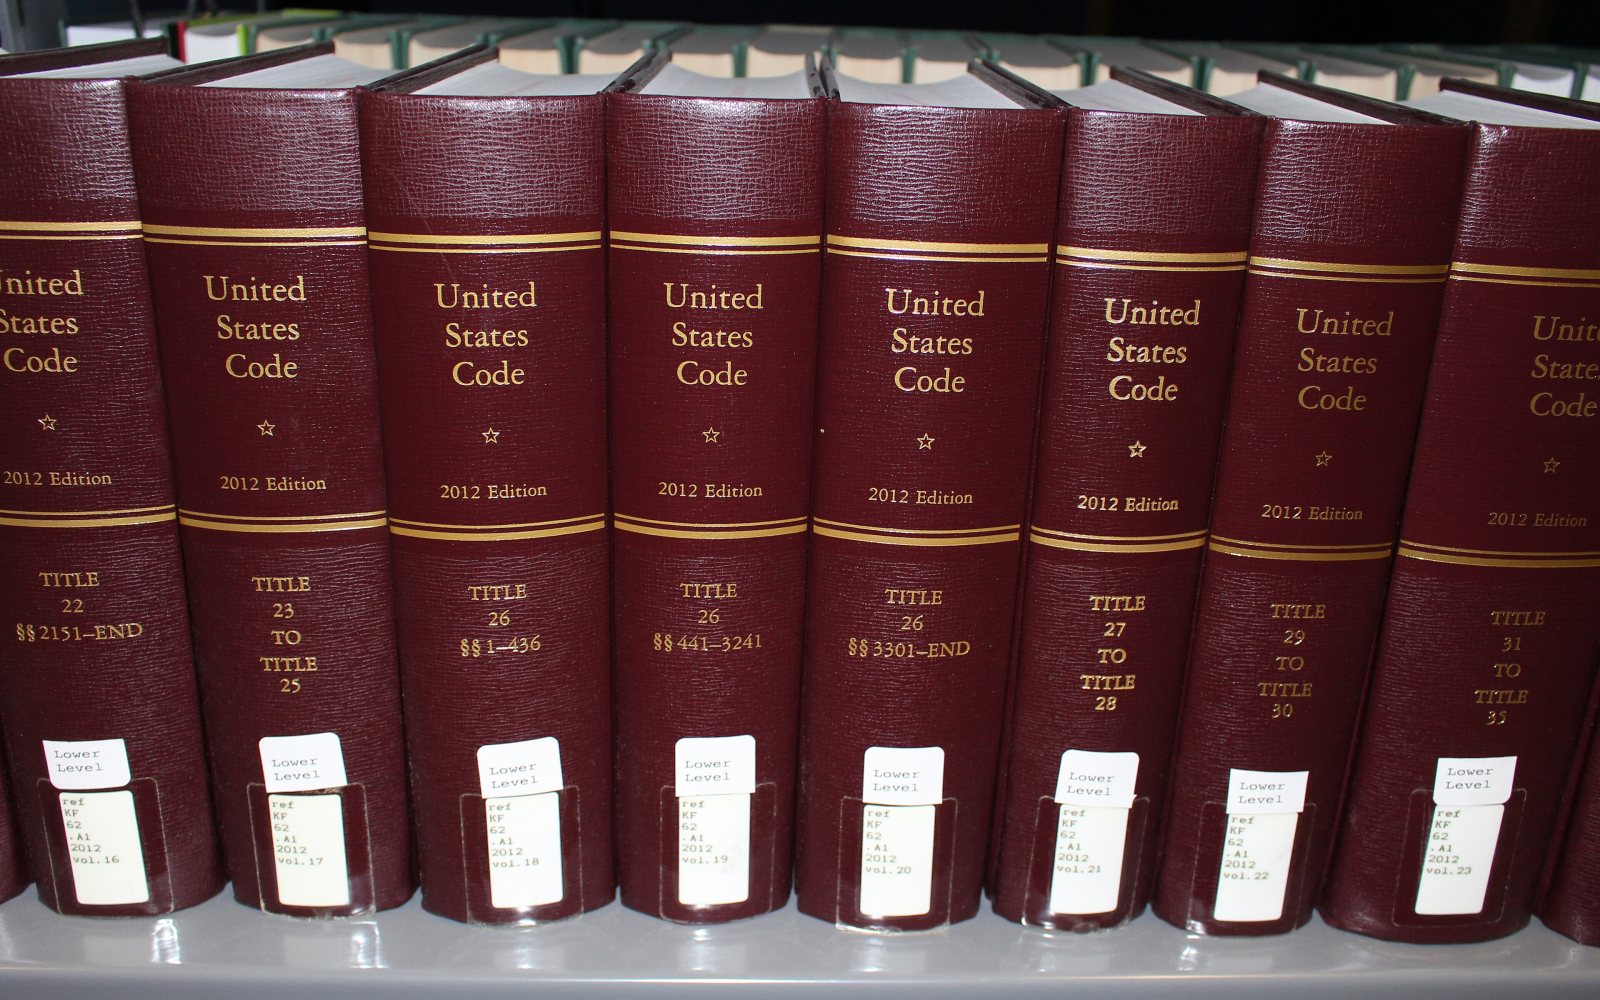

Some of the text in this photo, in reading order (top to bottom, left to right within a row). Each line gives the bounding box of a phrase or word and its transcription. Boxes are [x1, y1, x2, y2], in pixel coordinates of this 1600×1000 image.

[0, 270, 84, 297] nited
[203, 275, 307, 303] United
[434, 281, 538, 309] United
[663, 282, 764, 310] United
[885, 287, 985, 317] United
[1104, 298, 1202, 326] United
[217, 315, 301, 341] States
[1297, 308, 1394, 337] United
[445, 322, 529, 348] States
[672, 322, 754, 348] States
[891, 328, 974, 356] States
[1106, 337, 1187, 365] States
[3, 348, 79, 374] Code
[225, 354, 300, 379] Code
[1297, 347, 1378, 375] States
[1531, 354, 1600, 381] State
[452, 360, 526, 386] Code
[676, 360, 748, 386] Code
[894, 366, 966, 394] Code
[1108, 374, 1179, 403] Code
[1297, 385, 1368, 412] Code
[1529, 391, 1597, 418] Code
[3, 471, 112, 486] 2012 Edition
[219, 476, 327, 492] 2012 Edition
[440, 483, 548, 499] 2012 Edition
[658, 482, 763, 499] 2012 Edition
[868, 487, 974, 505] 2012 Edition
[1077, 495, 1180, 513] 2012 Edition
[1261, 504, 1364, 521] 2012 Edition
[1487, 511, 1588, 528] 2012 Edition
[39, 572, 100, 588] TITLE
[251, 576, 311, 592] TITLE
[468, 583, 528, 601] TITLE
[680, 582, 738, 599] TITLE
[885, 589, 943, 606] TITLE
[61, 599, 84, 613] 22
[273, 603, 294, 619] 23
[1089, 595, 1146, 612] TITLE
[488, 609, 511, 627] 26
[697, 608, 720, 625] 26
[1270, 604, 1326, 619] TITLE
[1491, 610, 1546, 626] TITLE
[900, 615, 924, 632] 26
[1103, 621, 1127, 638] 27
[271, 630, 302, 645] TO
[1283, 630, 1306, 646] 29
[1502, 637, 1522, 652] 31
[1097, 648, 1127, 664] TO
[1276, 656, 1305, 671] TO
[259, 657, 318, 672] TITLE
[1494, 663, 1522, 678] TO
[280, 678, 301, 694] 25
[1080, 674, 1136, 690] TITLE
[1258, 682, 1313, 698] TITLE
[1474, 689, 1529, 705] TITLE
[1094, 696, 1117, 711] 28
[1272, 703, 1294, 719] 30
[1485, 710, 1508, 726] 35
[54, 749, 101, 760] Lower
[57, 763, 104, 773] Level
[272, 757, 319, 768] Lower
[490, 762, 537, 776] Lower
[684, 759, 732, 769] Lower
[273, 770, 321, 781] Level
[684, 772, 732, 783] Level
[873, 768, 921, 780] Lower
[1068, 772, 1115, 783] Lower
[1447, 766, 1495, 777] Lower
[491, 775, 539, 789] Level
[873, 782, 919, 793] Level
[1239, 780, 1286, 792] Lower
[1445, 779, 1492, 791] Level
[1067, 785, 1112, 797] Level
[62, 798, 85, 806] ref
[272, 800, 294, 809] ref
[682, 799, 706, 808] ref
[1238, 794, 1284, 805] Level
[64, 809, 80, 818] KF
[488, 803, 512, 812] ref
[681, 810, 697, 820] KF
[867, 808, 890, 818] ref
[1063, 808, 1087, 818] ref
[1437, 809, 1462, 819] ref
[273, 812, 288, 820] KF
[489, 814, 505, 823] KF
[1061, 819, 1078, 828] KF
[1231, 815, 1256, 825] ref
[66, 821, 82, 830] 62
[274, 823, 290, 832] 62
[489, 826, 506, 835] 62
[681, 822, 698, 831] 62
[866, 820, 882, 829] KF
[1229, 826, 1246, 835] KF
[1435, 820, 1451, 829] KF
[866, 831, 882, 841] 62
[1060, 831, 1077, 840] 62
[1228, 838, 1244, 847] 62
[1432, 831, 1449, 841] 62
[70, 844, 102, 853] 2012
[276, 845, 308, 854] 2012
[491, 847, 524, 856] 2012
[681, 844, 714, 853] 2012
[866, 854, 898, 864] 2012
[1058, 853, 1090, 863] 2012
[1225, 860, 1257, 869] 2012
[1428, 854, 1460, 864] 2012
